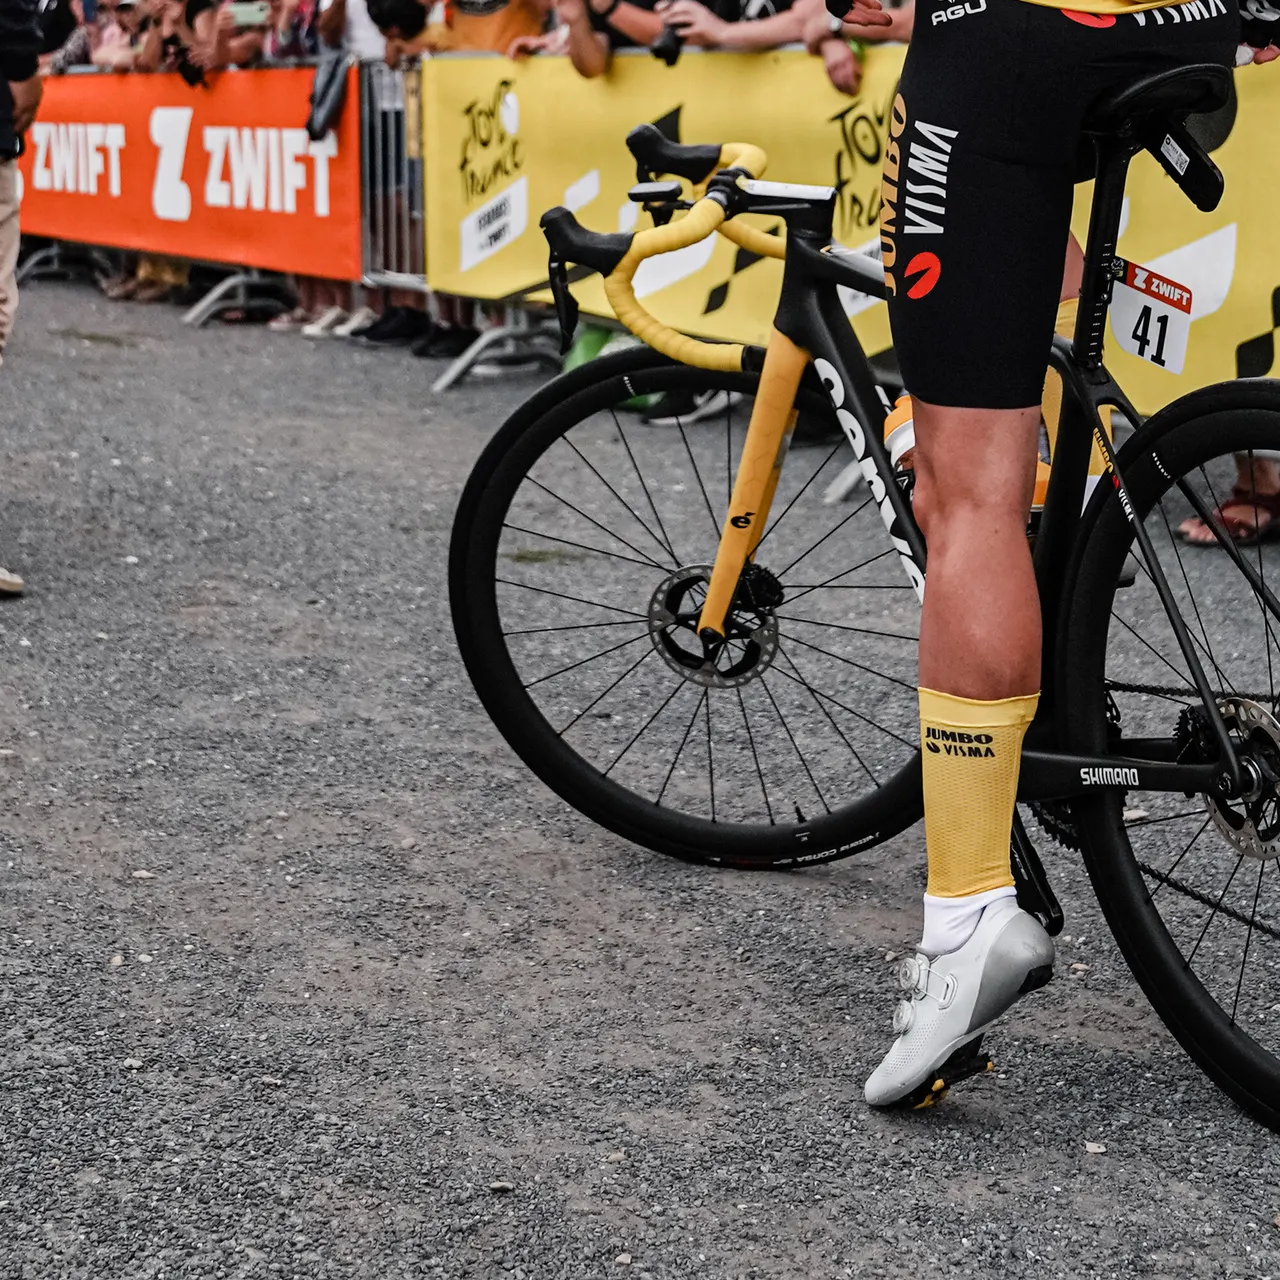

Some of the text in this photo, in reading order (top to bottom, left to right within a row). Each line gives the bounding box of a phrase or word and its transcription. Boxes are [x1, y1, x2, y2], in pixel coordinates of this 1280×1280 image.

[31, 121, 126, 198] ZWIFT
[203, 125, 339, 218] ZWIFT
[903, 120, 960, 235] VISMA
[1150, 277, 1190, 307] ZWIFT
[1131, 304, 1169, 368] 41
[925, 726, 994, 745] JUMBO
[943, 744, 996, 758] VISMA
[1080, 767, 1139, 787] SHIMANO
